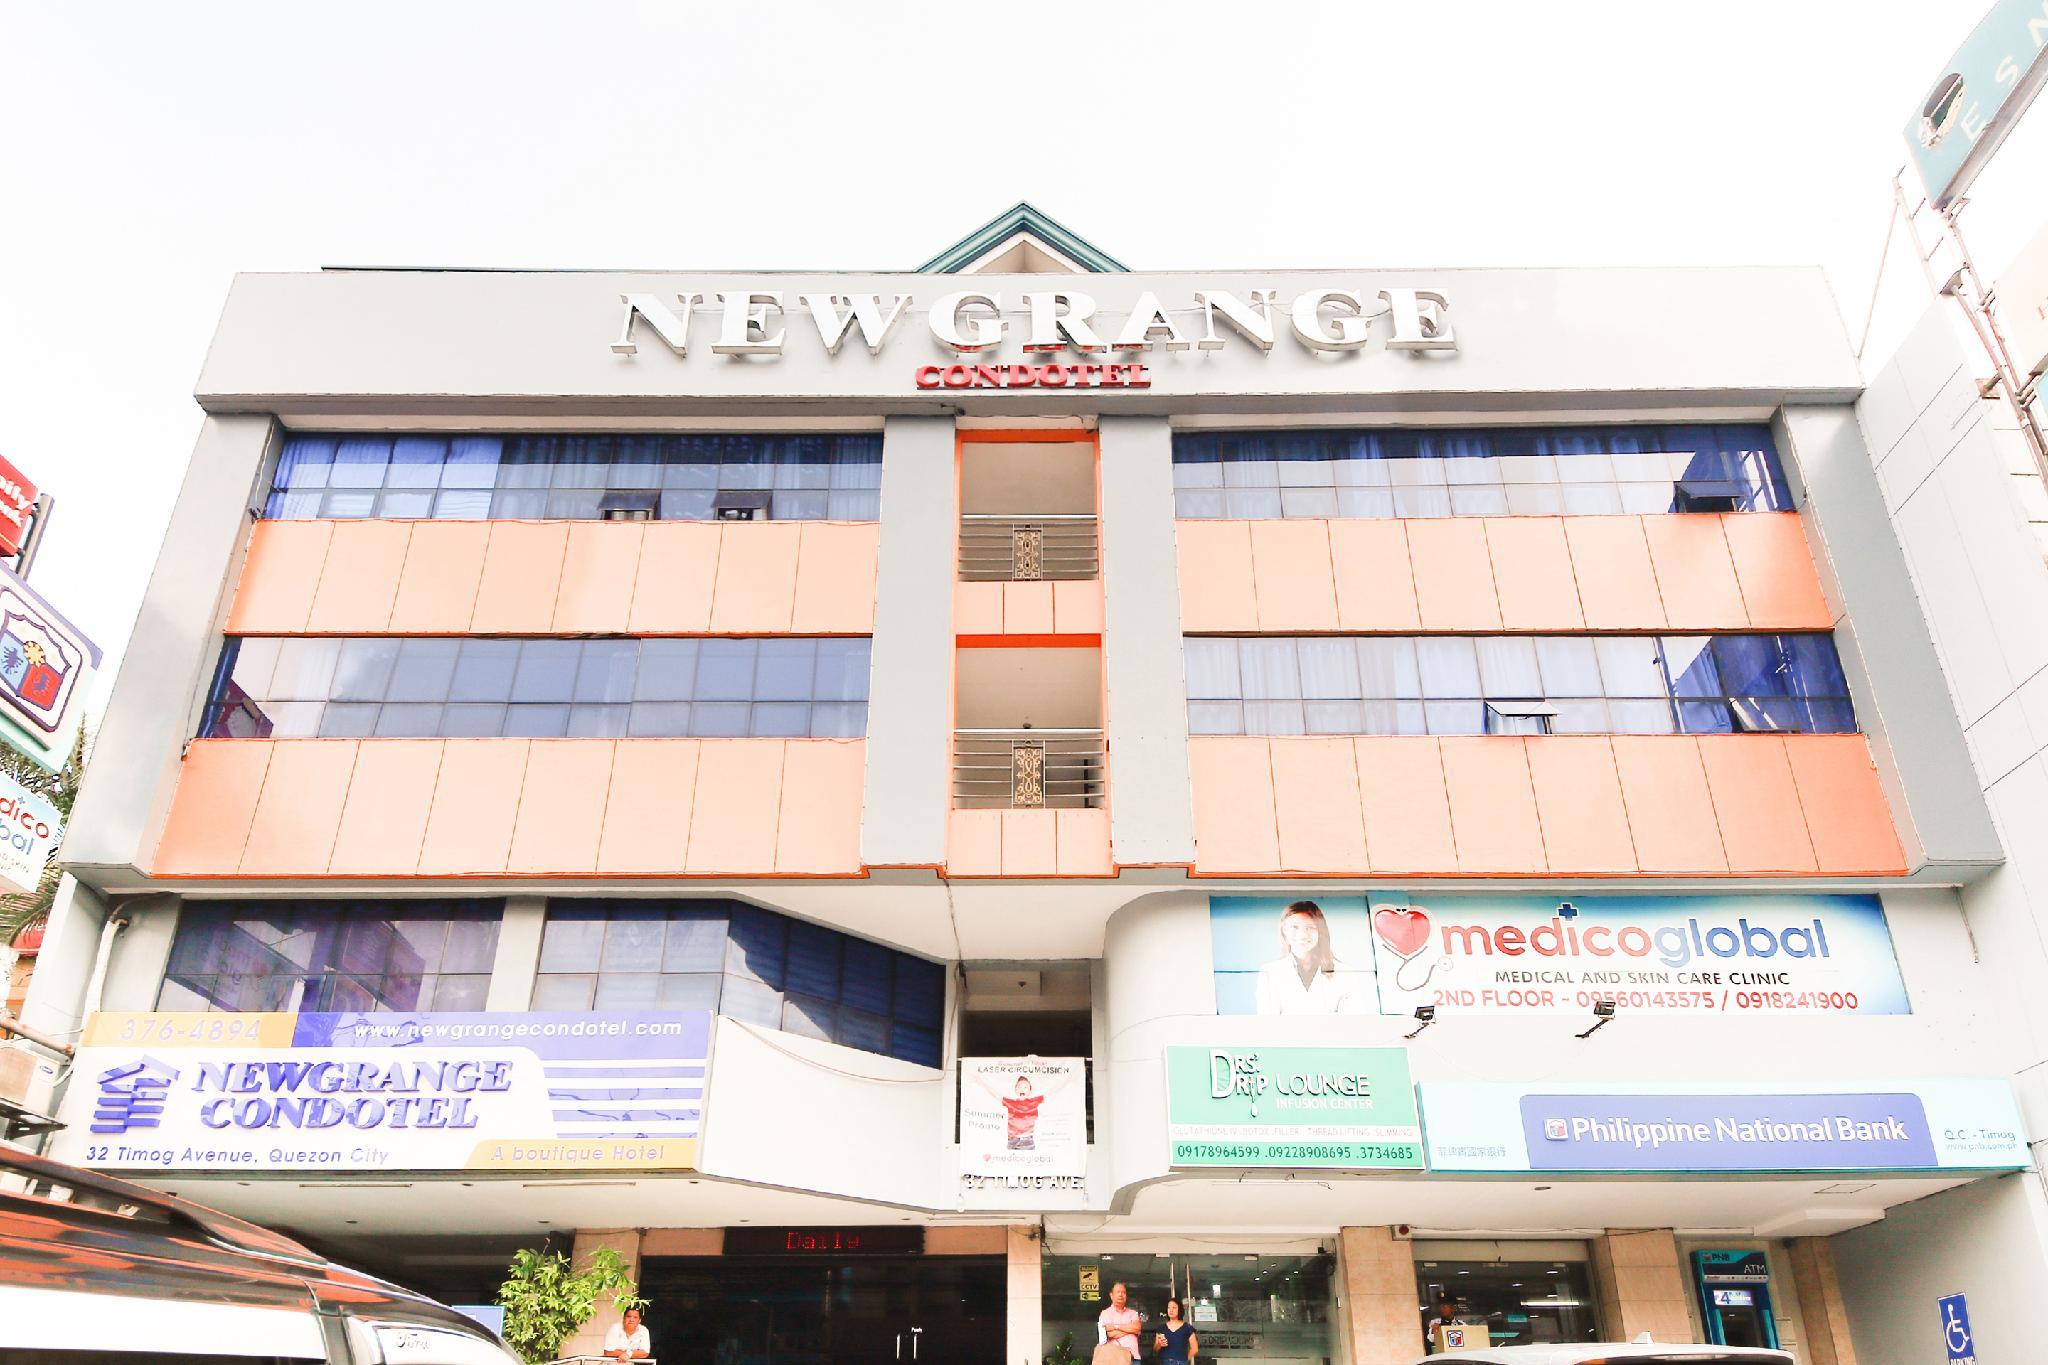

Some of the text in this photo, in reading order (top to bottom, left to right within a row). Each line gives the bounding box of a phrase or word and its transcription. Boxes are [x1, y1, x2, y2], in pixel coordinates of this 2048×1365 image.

[609, 287, 1459, 355] NEWGRANGE
[915, 363, 1152, 390] CONDOTEL
[1441, 908, 1829, 968] medicoglobal
[1495, 971, 1791, 985] MEDICAL AND SKIN CARE CLINIC
[1433, 990, 1475, 1007] 2ND
[1482, 990, 1553, 1008] FLOOR
[1576, 991, 1715, 1009] 09560143575
[1735, 991, 1859, 1010] 0918241900
[119, 1018, 262, 1041] 376-4894
[354, 1020, 683, 1040] www.newgrangecondotel.com
[191, 1060, 514, 1093] NEWGRANGE
[977, 1065, 1070, 1075] LASER CIRCUMCISION
[1275, 1072, 1371, 1097] LOUNGE
[199, 1097, 480, 1130] CONDOTEL
[1275, 1097, 1374, 1110] INFUSION CENTER
[1570, 1115, 1910, 1149] Philippine National Bank
[1979, 1129, 2016, 1142] Timog
[86, 1146, 389, 1166] 32 Timog Avenue, Quezon City
[490, 1146, 665, 1163] A boutique Hotel
[1177, 1145, 1260, 1159] 09178964599
[787, 1231, 862, 1249] Daily
[1743, 1264, 1767, 1274] ATM
